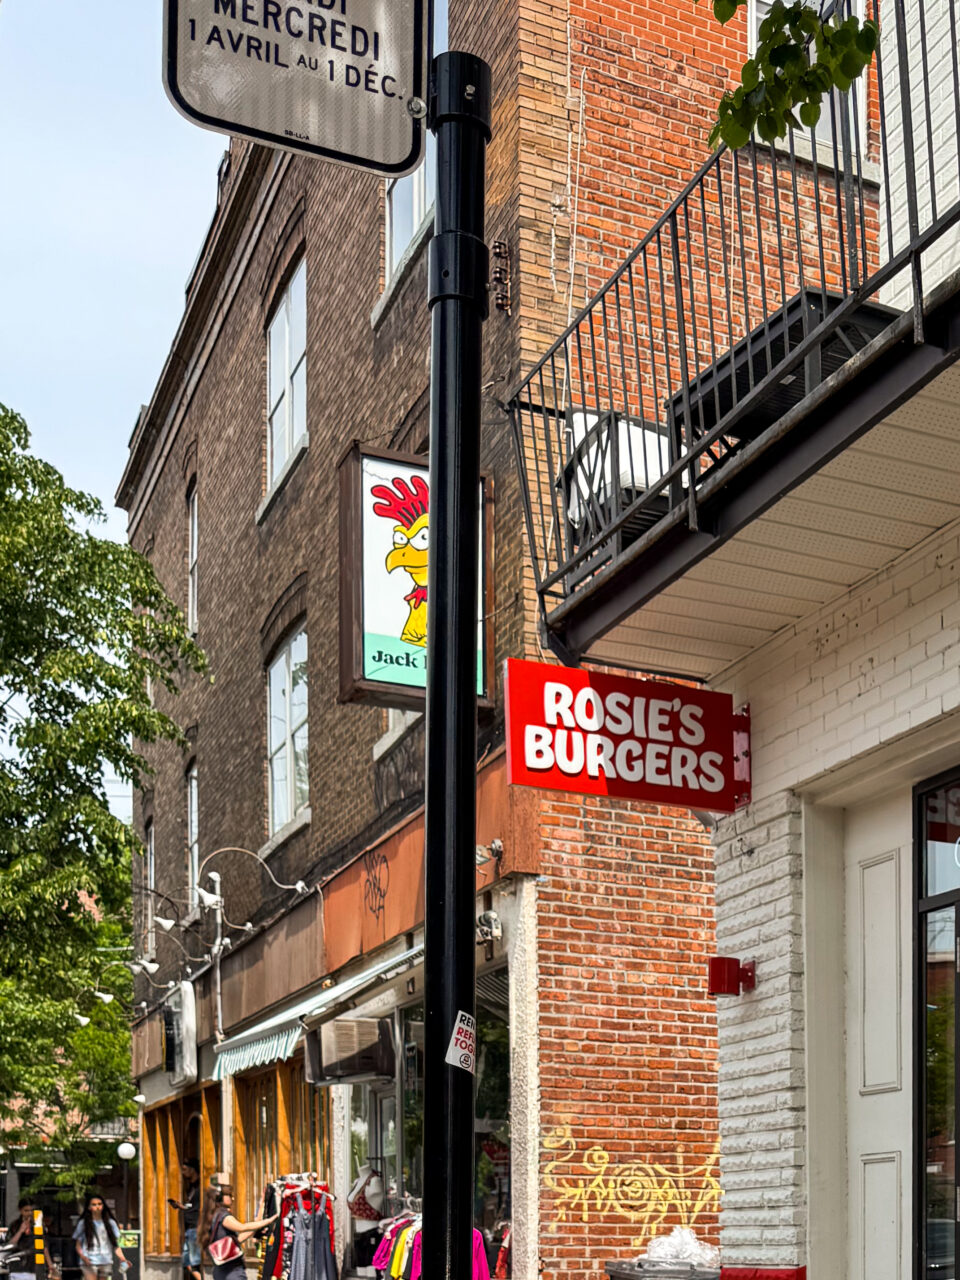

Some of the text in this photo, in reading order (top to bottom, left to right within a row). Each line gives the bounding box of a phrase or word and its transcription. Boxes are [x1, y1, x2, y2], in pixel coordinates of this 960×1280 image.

[189, 19, 404, 100] 1 AVRIL AU 1 DÉC.
[214, 0, 379, 61] MERCREDI
[372, 650, 418, 668] Jack
[544, 681, 705, 746] ROSIE'S
[524, 724, 725, 793] BURGERS
[454, 1037, 475, 1056] TOG
